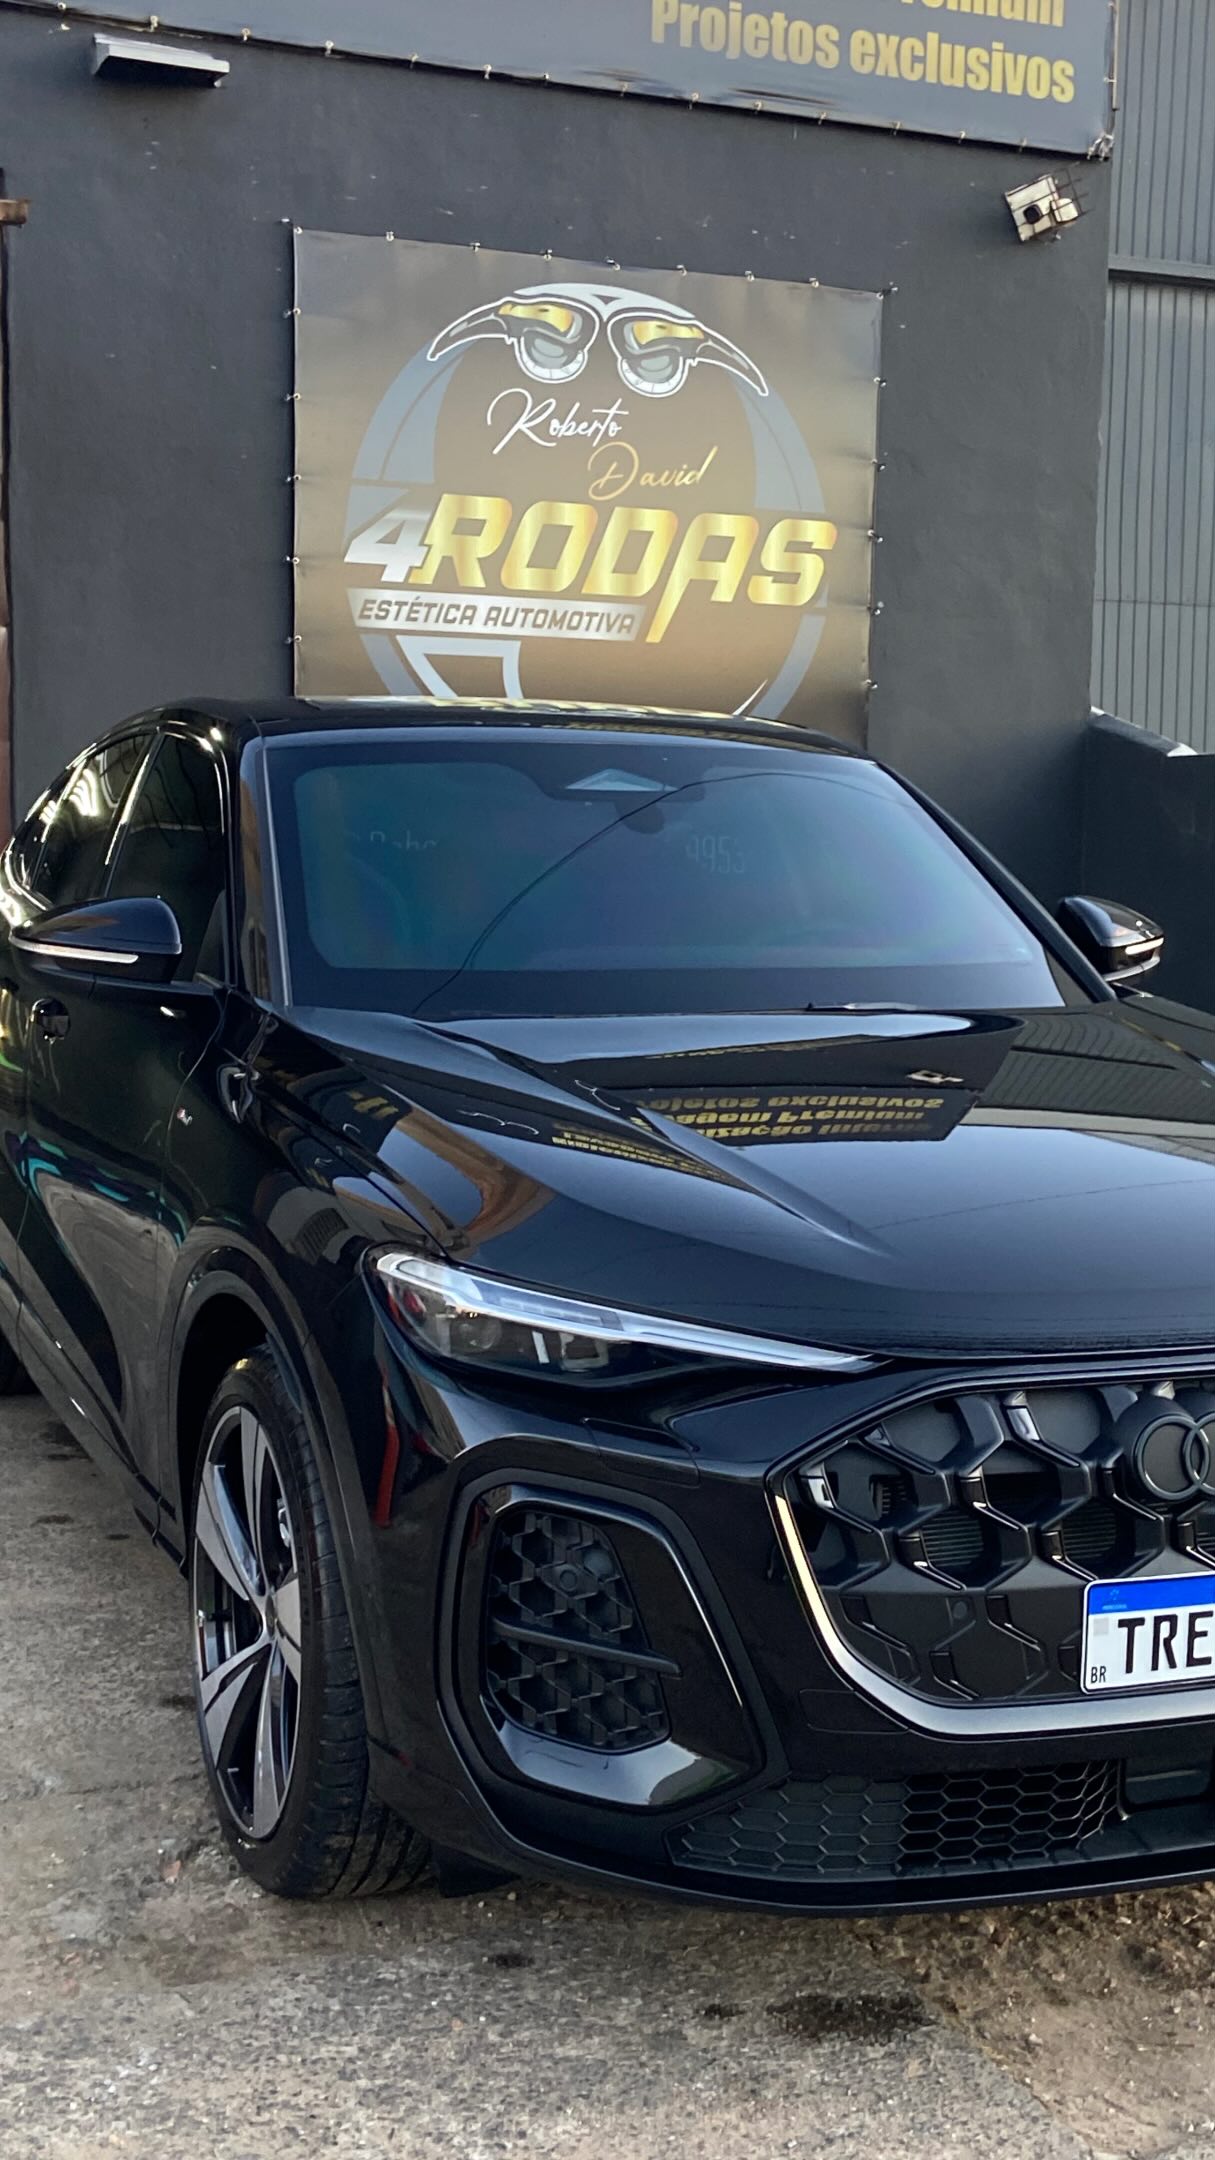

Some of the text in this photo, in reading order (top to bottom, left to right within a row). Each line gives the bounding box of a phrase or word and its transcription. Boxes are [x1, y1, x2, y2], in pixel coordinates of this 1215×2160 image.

[651, 0, 1075, 104] Projetos exclusivos
[487, 388, 629, 454] Roberto
[587, 442, 718, 501] David
[358, 595, 635, 635] ESTÉTICA AUTOMOTIVA
[1090, 1665, 1107, 1684] BR
